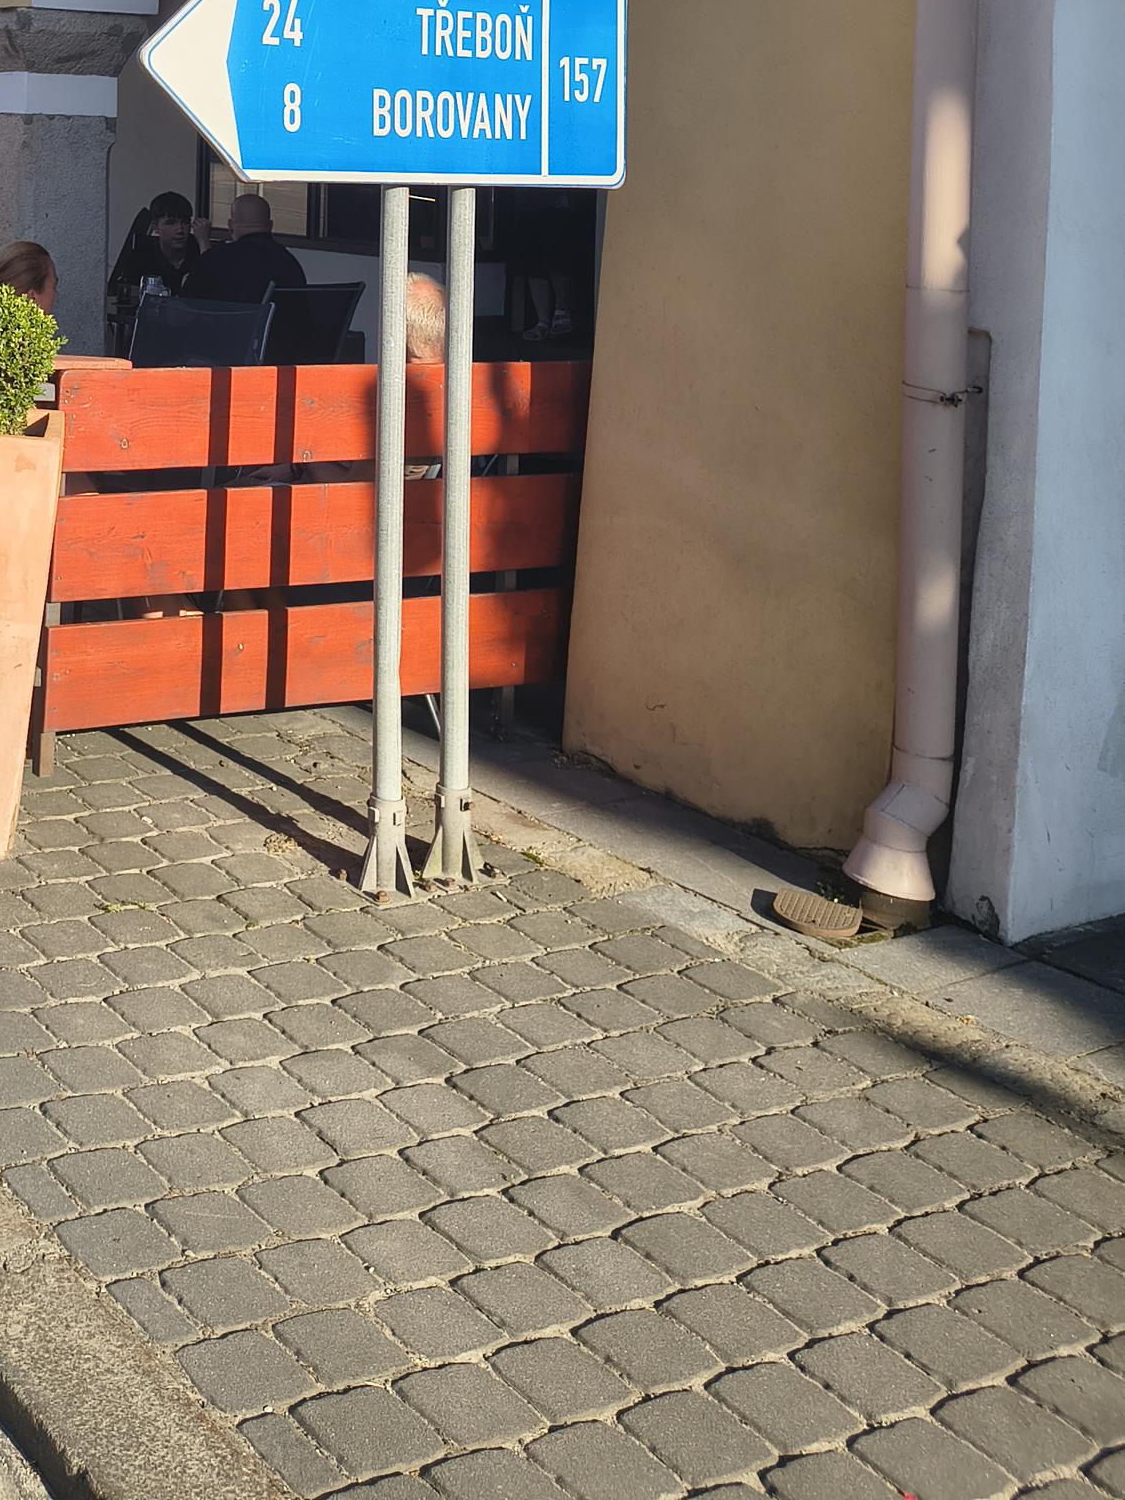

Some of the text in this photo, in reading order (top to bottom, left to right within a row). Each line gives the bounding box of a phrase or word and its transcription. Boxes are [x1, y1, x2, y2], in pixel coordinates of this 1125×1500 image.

[559, 56, 607, 103] 157
[283, 82, 532, 140] 8 BOROVANY
